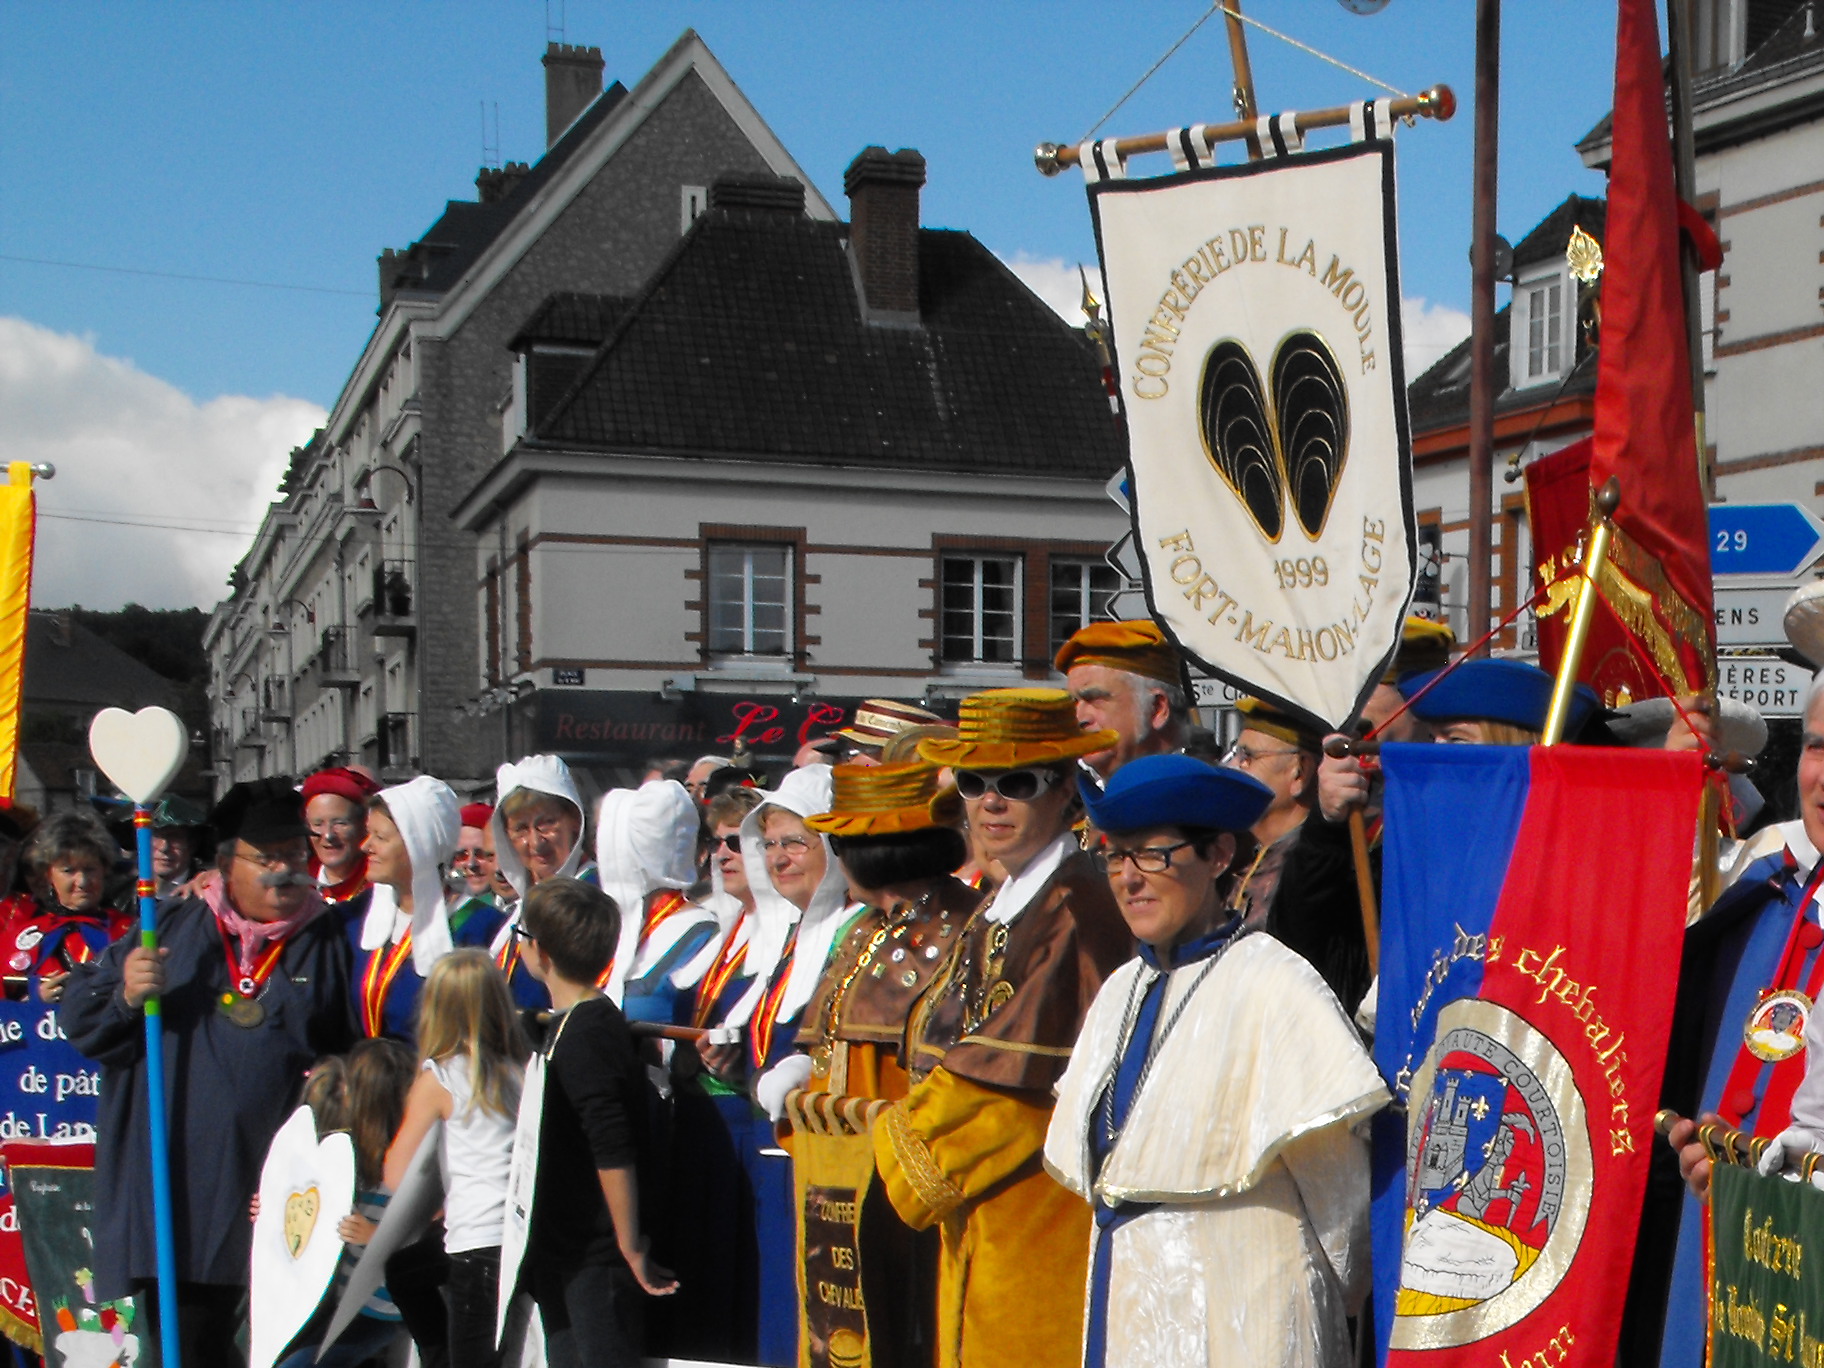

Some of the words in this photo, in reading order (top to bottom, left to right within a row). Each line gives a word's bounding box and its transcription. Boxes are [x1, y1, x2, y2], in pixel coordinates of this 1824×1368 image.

[1132, 235, 1231, 400] CONFRÉRIE
[1228, 225, 1267, 265] DE
[1276, 227, 1317, 277] LA
[1319, 253, 1377, 376] MOULE
[1273, 555, 1330, 590] 1999
[554, 713, 706, 743] Restaurant
[716, 701, 785, 744] Le
[20, 1064, 48, 1094] de
[1502, 1058, 1566, 1216] COURTOISIE
[831, 1246, 853, 1271] DES
